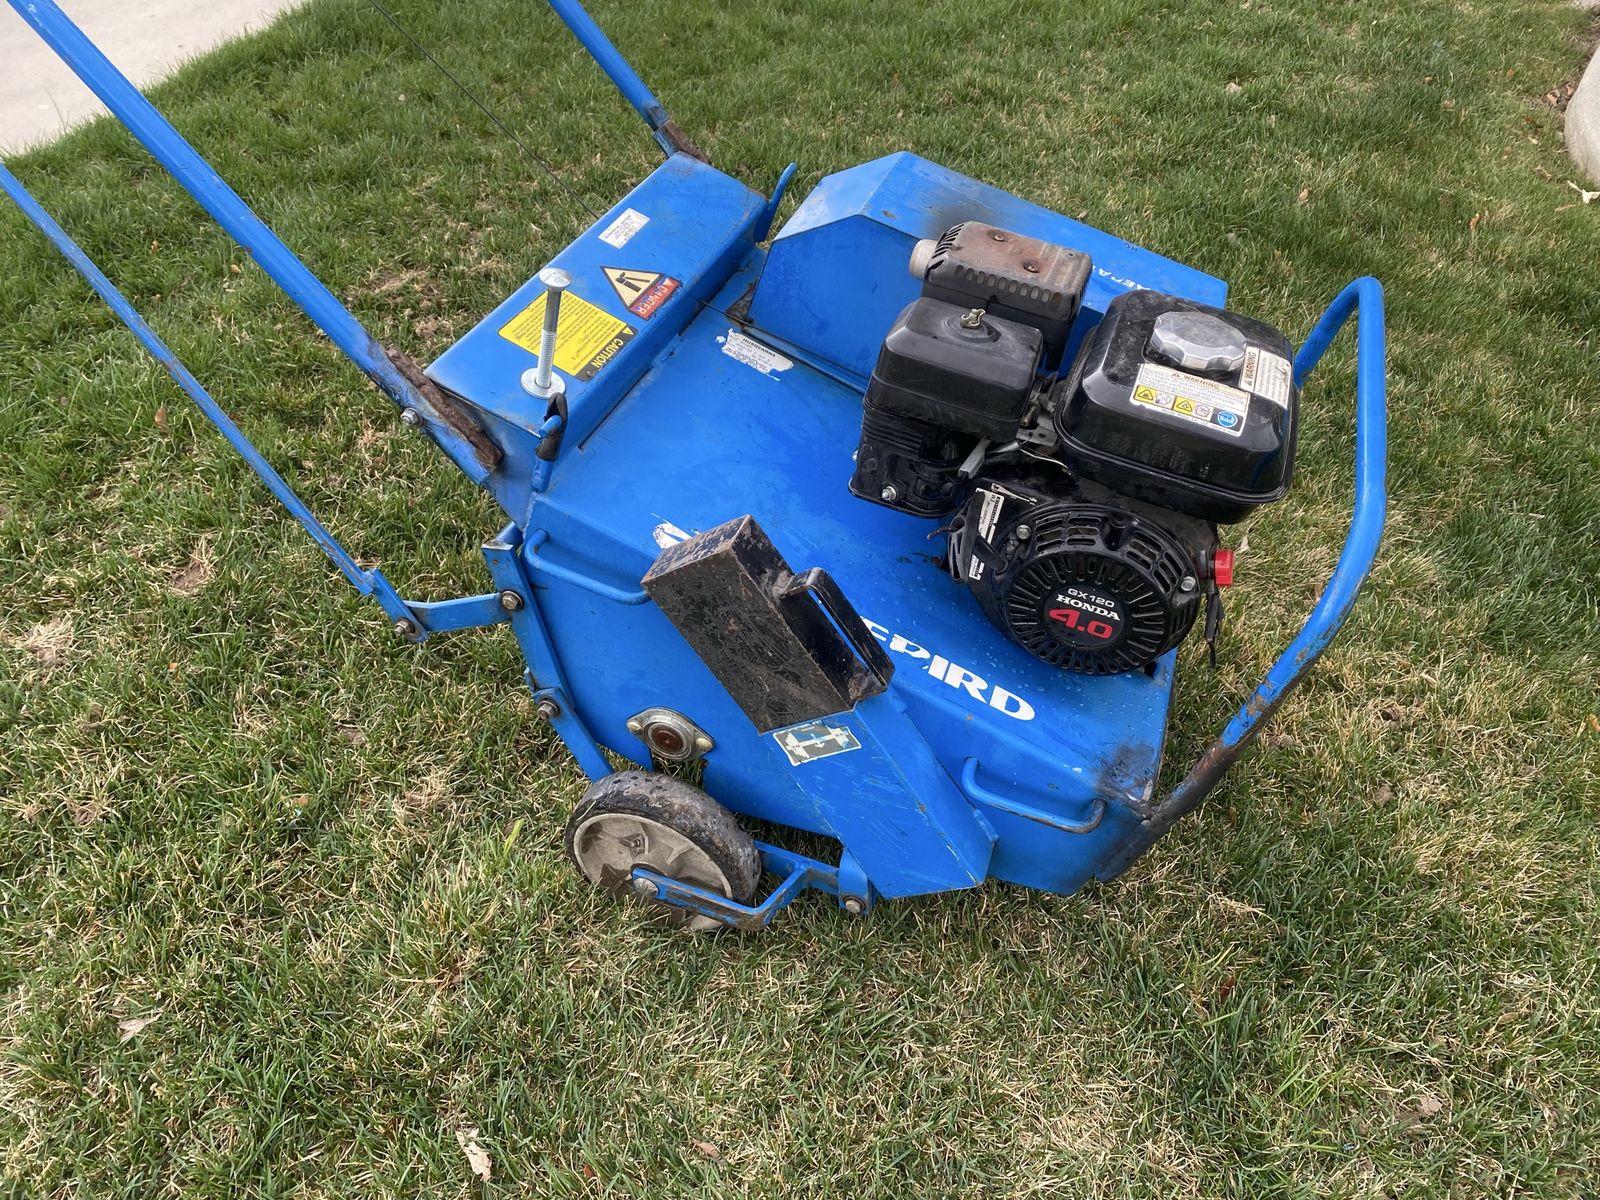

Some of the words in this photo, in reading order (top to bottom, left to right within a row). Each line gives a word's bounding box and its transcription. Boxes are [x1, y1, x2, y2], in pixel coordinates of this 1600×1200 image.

[636, 284, 668, 315] DANGER
[590, 338, 624, 369] CAUTION
[743, 338, 776, 358] HUSQVARNA
[1245, 351, 1257, 378] WARNING
[1183, 375, 1220, 390] WARNING
[1056, 594, 1120, 621] HONDA
[1048, 608, 1113, 639] 4.0
